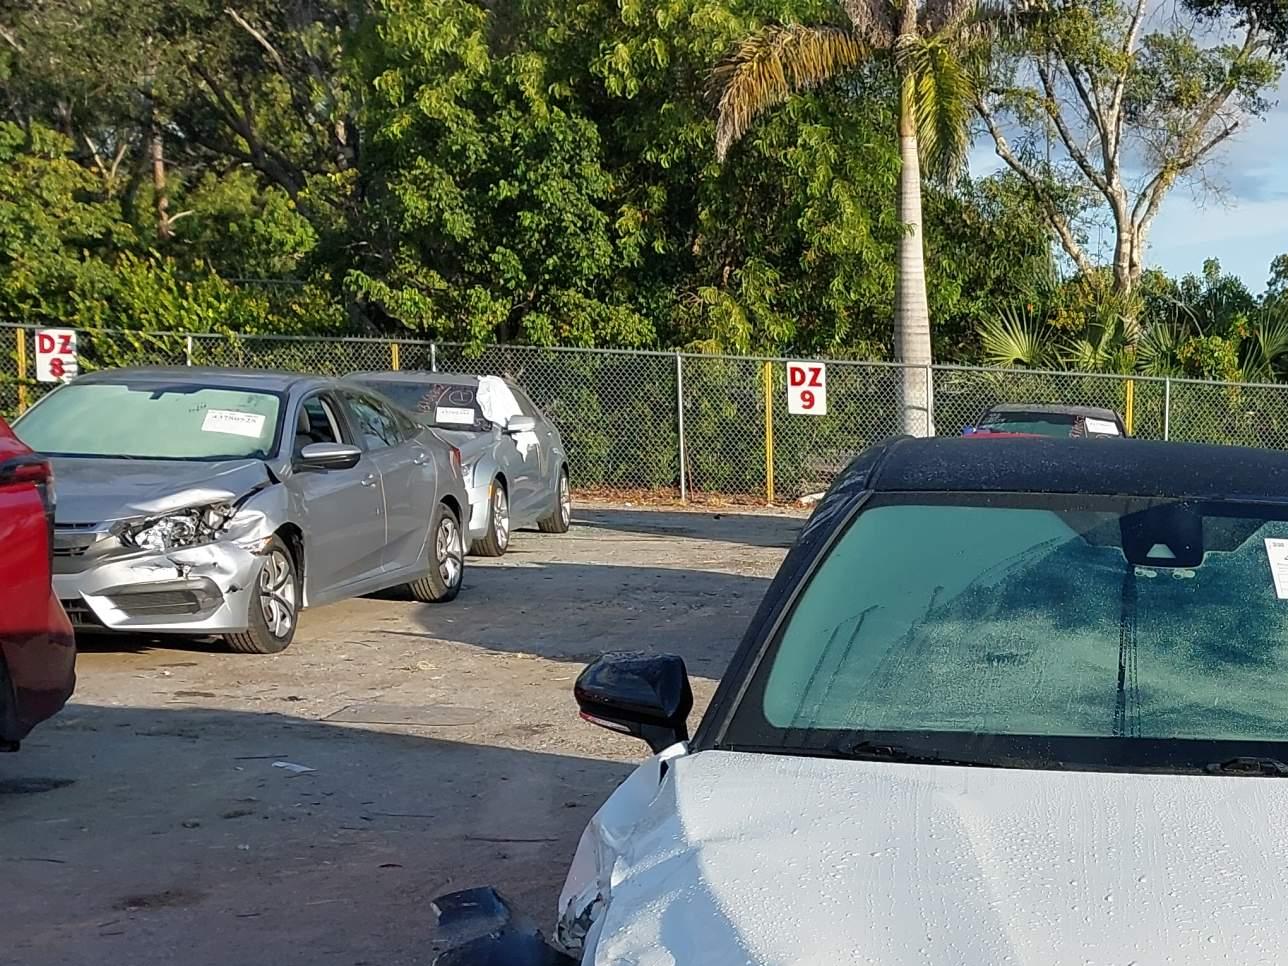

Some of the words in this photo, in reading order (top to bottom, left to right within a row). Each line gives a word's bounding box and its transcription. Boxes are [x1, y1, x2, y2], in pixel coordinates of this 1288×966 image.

[38, 333, 73, 354] DZ
[49, 357, 65, 378] 8
[790, 366, 823, 387] DZ
[800, 389, 816, 410] 9
